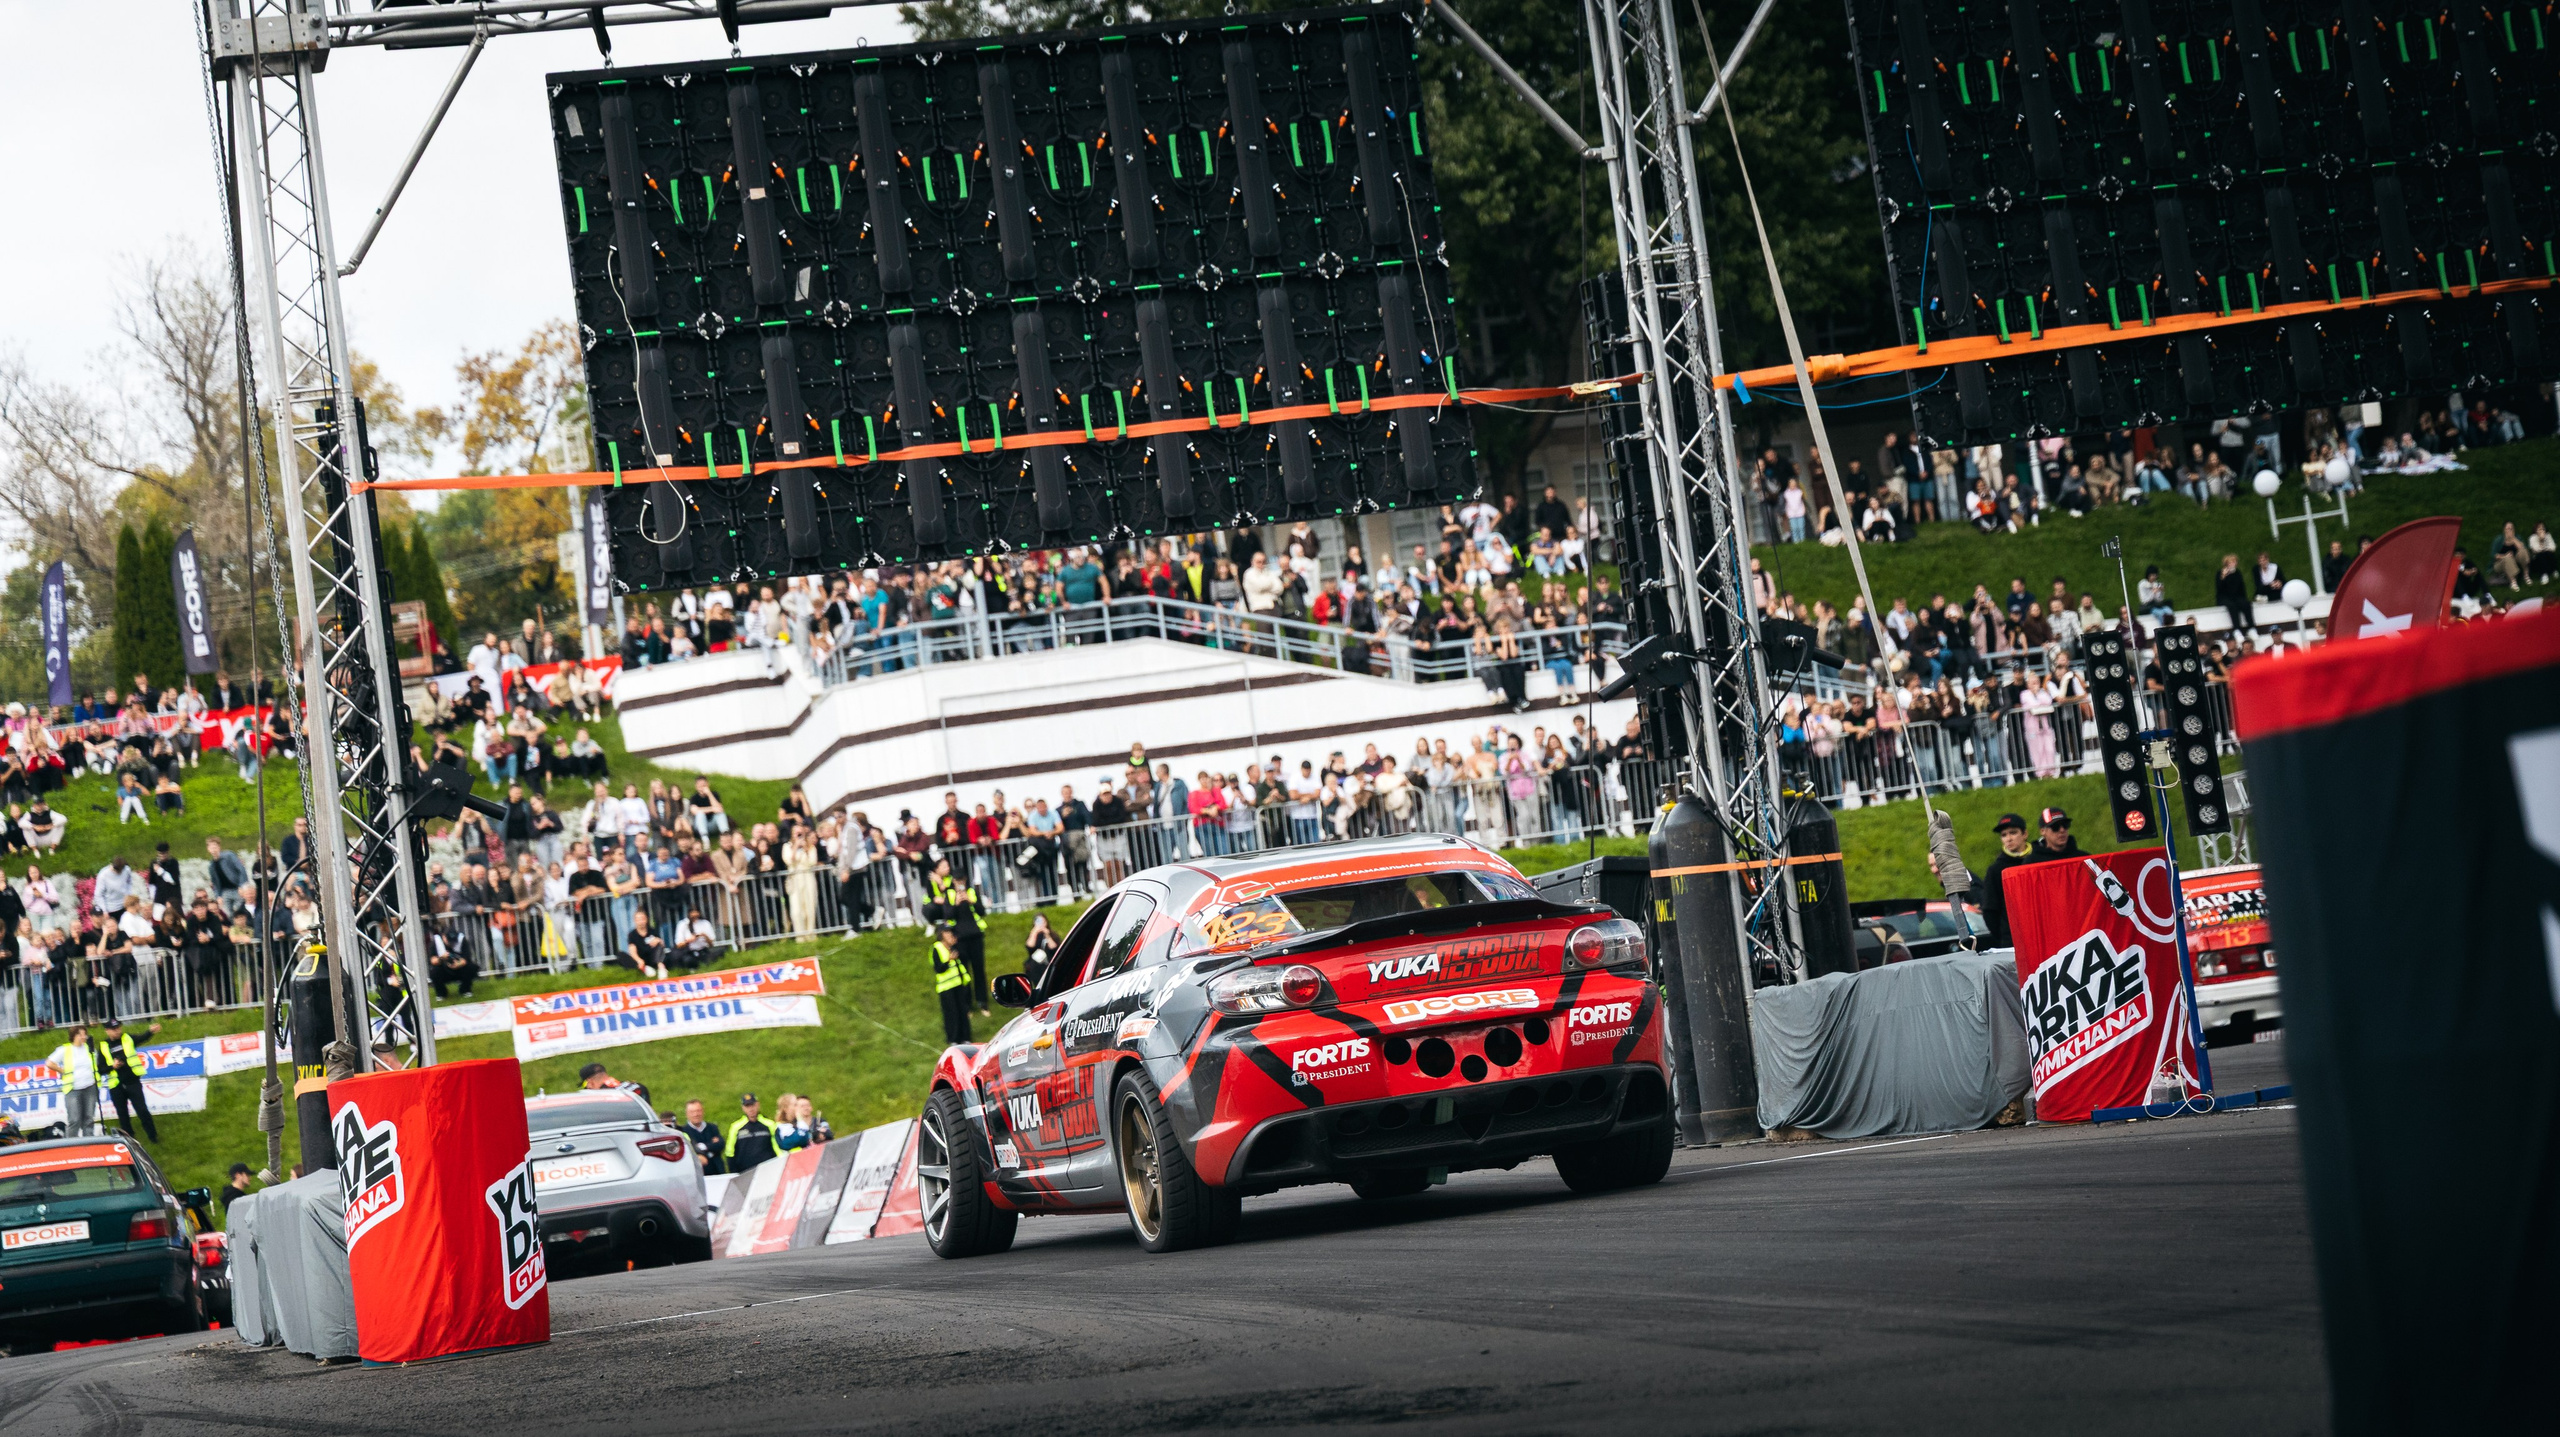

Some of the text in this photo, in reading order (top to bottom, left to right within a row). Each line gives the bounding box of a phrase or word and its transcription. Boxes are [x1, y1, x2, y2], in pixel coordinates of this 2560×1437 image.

[1201, 911, 1292, 948] 123
[2216, 927, 2251, 947] 13
[1368, 953, 1440, 983] YUKA
[2022, 936, 2116, 1032] YUKA
[582, 998, 752, 1035] DINITROL
[1568, 1002, 1632, 1028] FORTIS
[2028, 952, 2144, 1067] DRIVE
[1586, 1026, 1635, 1042] PRESIDENT
[2034, 1002, 2142, 1087] GYMKHANA
[1292, 1038, 1370, 1071] FORTIS
[1309, 1063, 1372, 1081] PRESIDENT
[1008, 1093, 1043, 1131] YUKA
